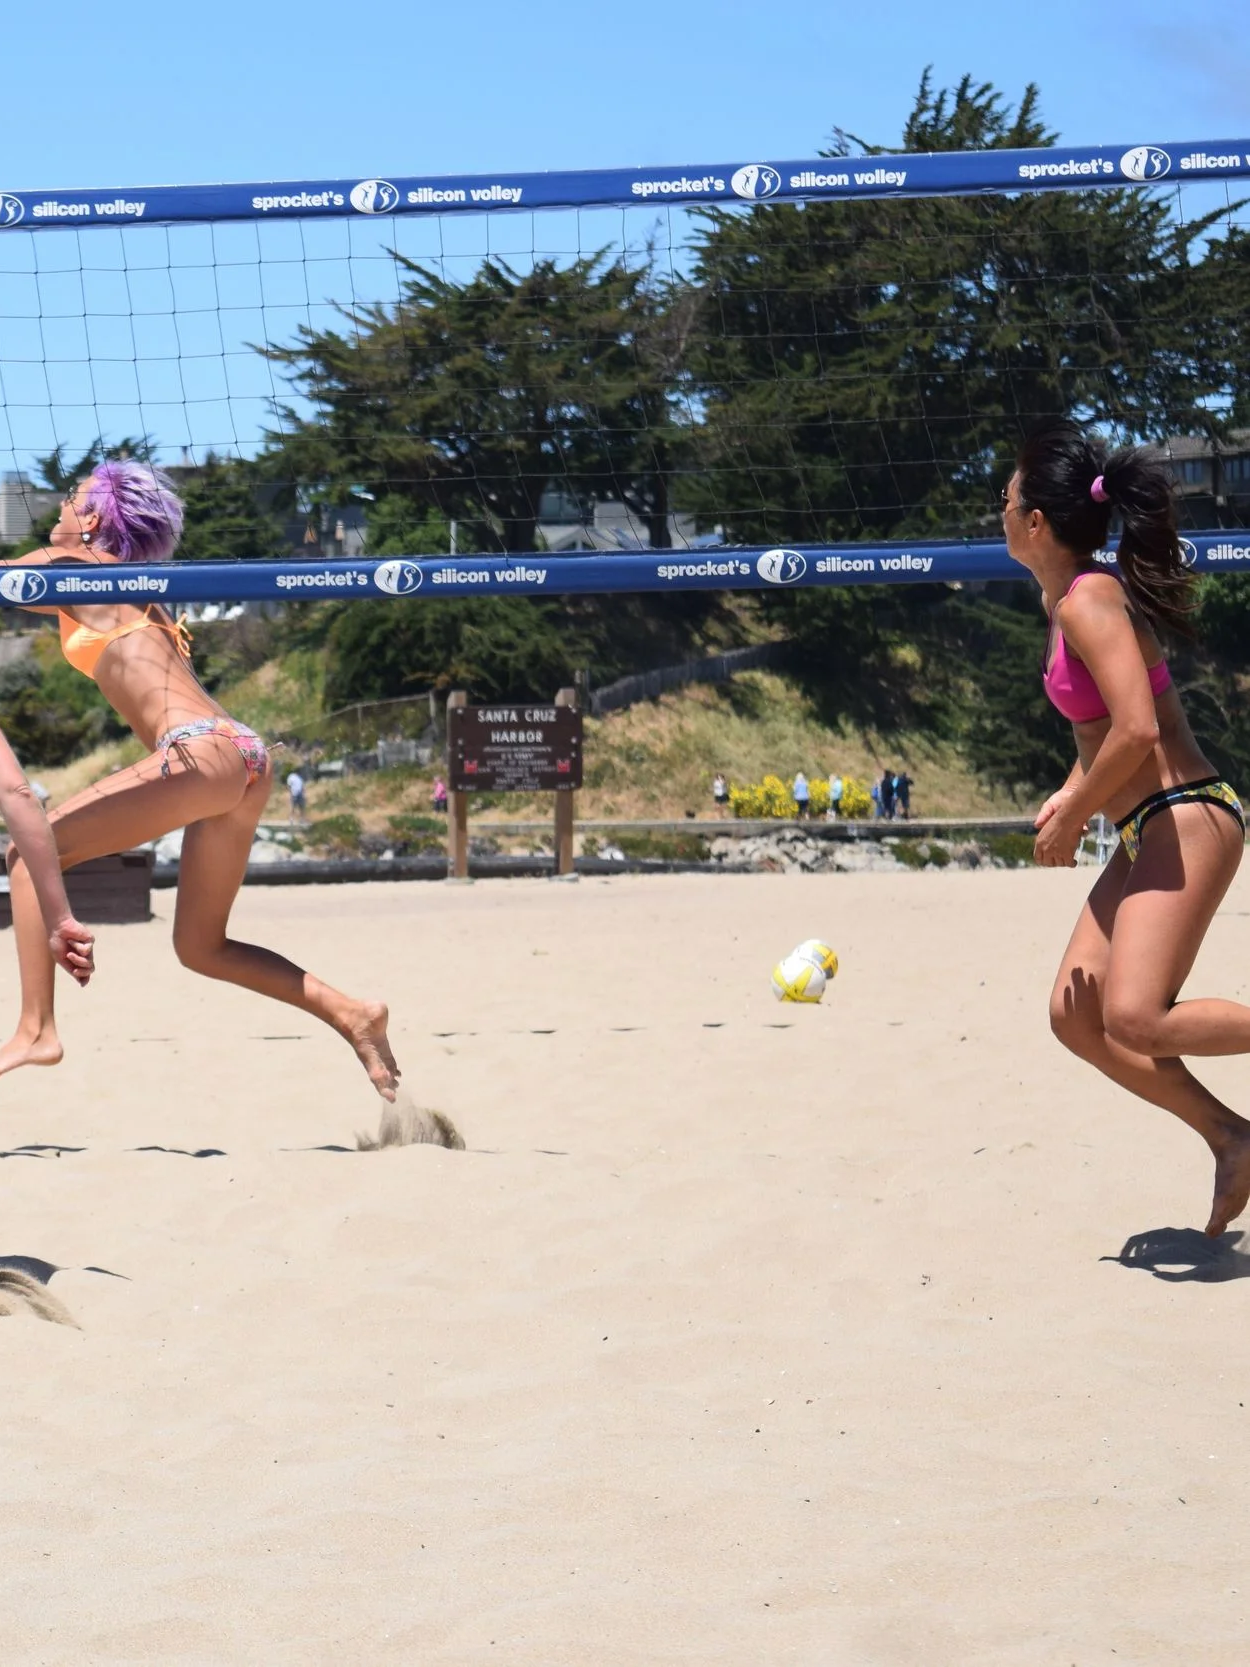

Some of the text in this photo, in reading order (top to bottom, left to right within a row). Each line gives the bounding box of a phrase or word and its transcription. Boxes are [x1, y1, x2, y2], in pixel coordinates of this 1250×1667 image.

[1019, 159, 1113, 179] sprocket's
[1181, 153, 1240, 169] silicon
[632, 169, 906, 197] sprocket's silicon volley
[253, 186, 522, 210] sprocket's silicon volley
[33, 202, 90, 217] silicon
[95, 200, 145, 216] volley
[1207, 544, 1250, 560] silico
[658, 555, 933, 579] sprocket's silicon volley
[56, 577, 112, 592] silicon
[118, 576, 168, 593] volley
[277, 567, 546, 589] sprocket's silicon volley
[477, 709, 557, 722] SANTA CRUZ
[490, 731, 544, 743] HARBOR
